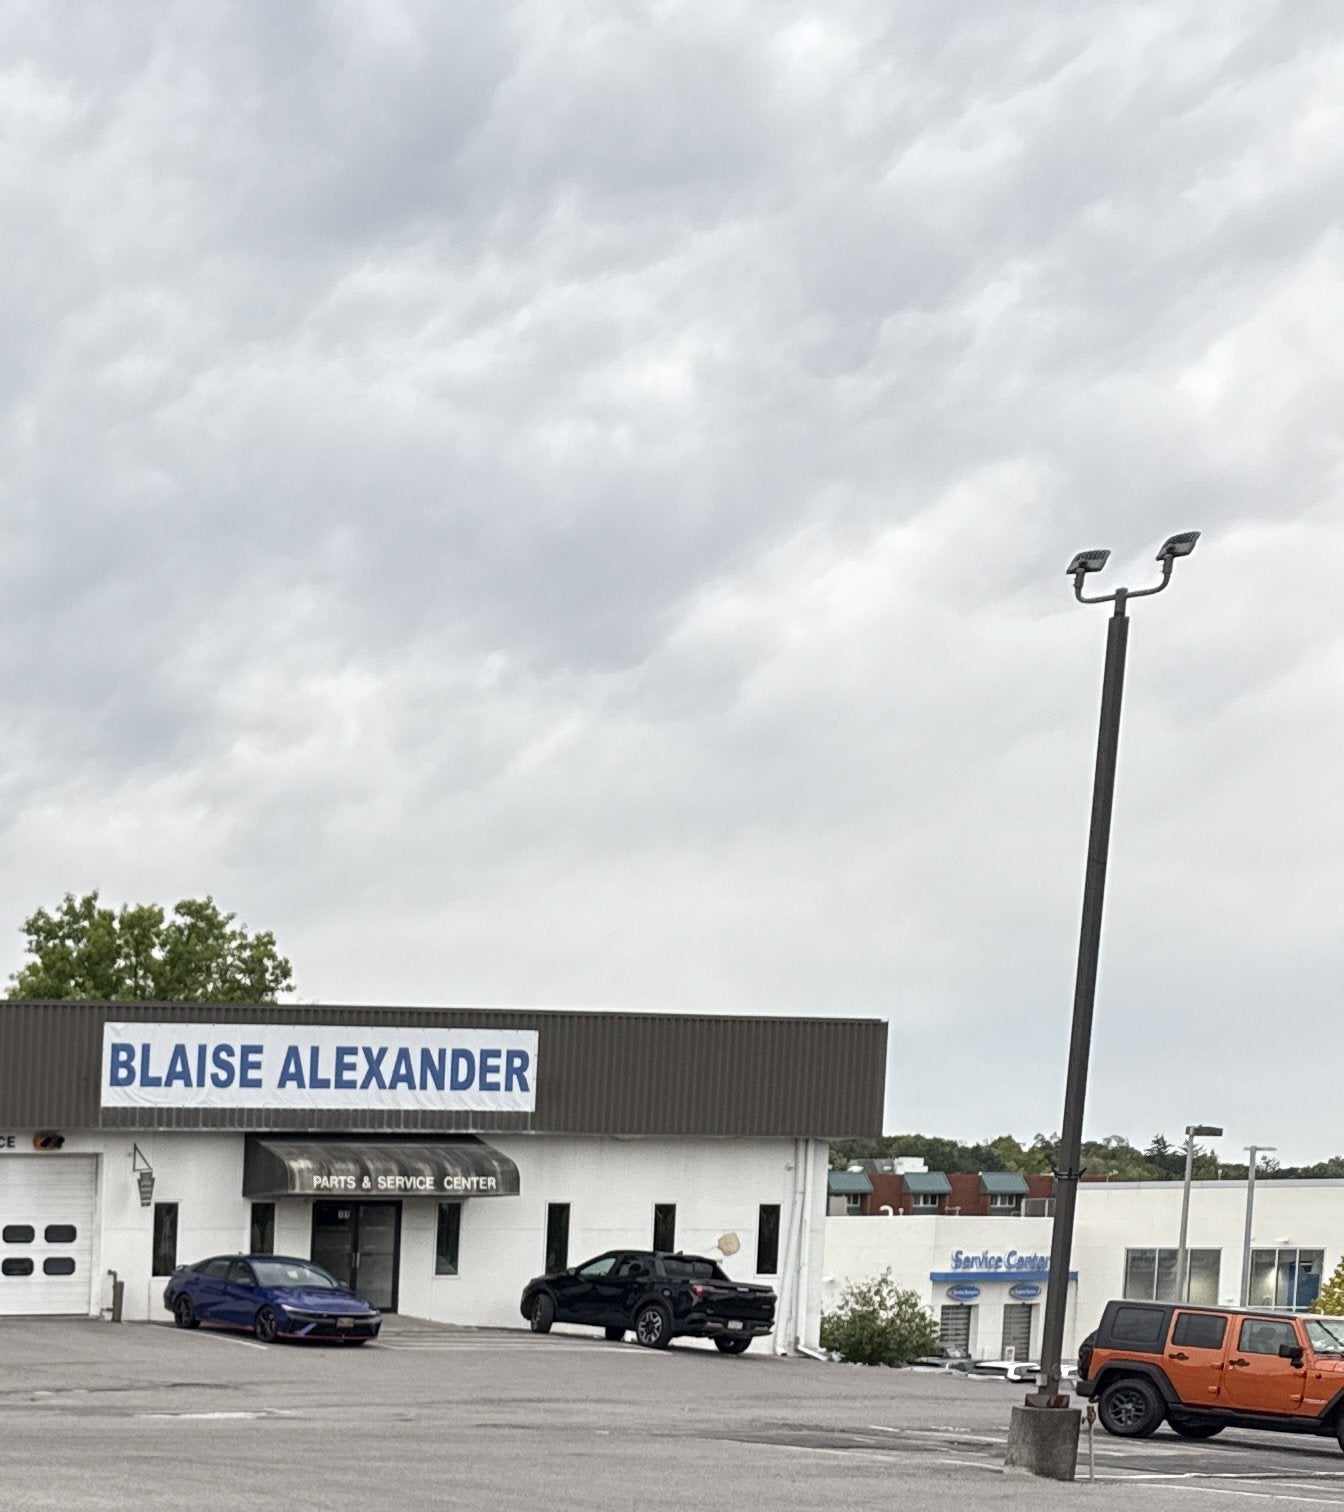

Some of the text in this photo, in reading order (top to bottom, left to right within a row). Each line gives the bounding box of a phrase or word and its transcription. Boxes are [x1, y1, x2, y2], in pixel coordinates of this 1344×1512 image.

[109, 1042, 530, 1092] BLAISE ALEXANDER
[313, 1175, 497, 1190] PARTS & SERVICE CENTER
[953, 1250, 1051, 1270] Service Center
